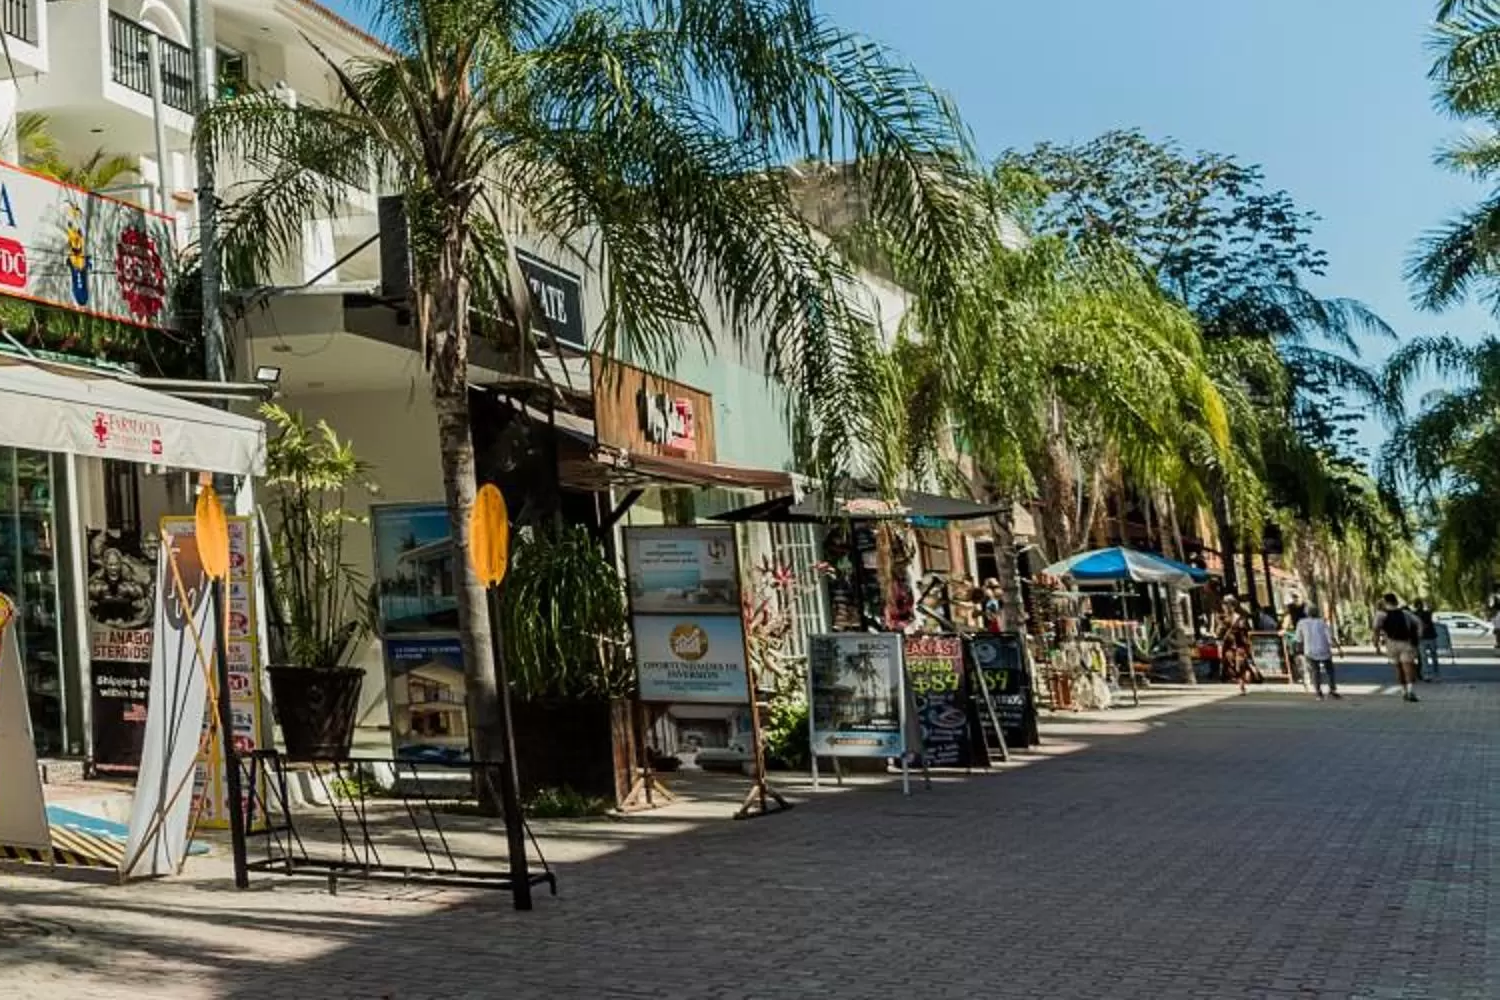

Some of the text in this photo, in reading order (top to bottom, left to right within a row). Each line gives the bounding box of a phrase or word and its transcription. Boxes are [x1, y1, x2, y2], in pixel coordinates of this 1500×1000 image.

[109, 631, 154, 645] ANABO
[92, 645, 150, 660] STEROIDS
[96, 675, 138, 689] Shipping
[912, 672, 960, 695] $89
[130, 689, 146, 699] the
